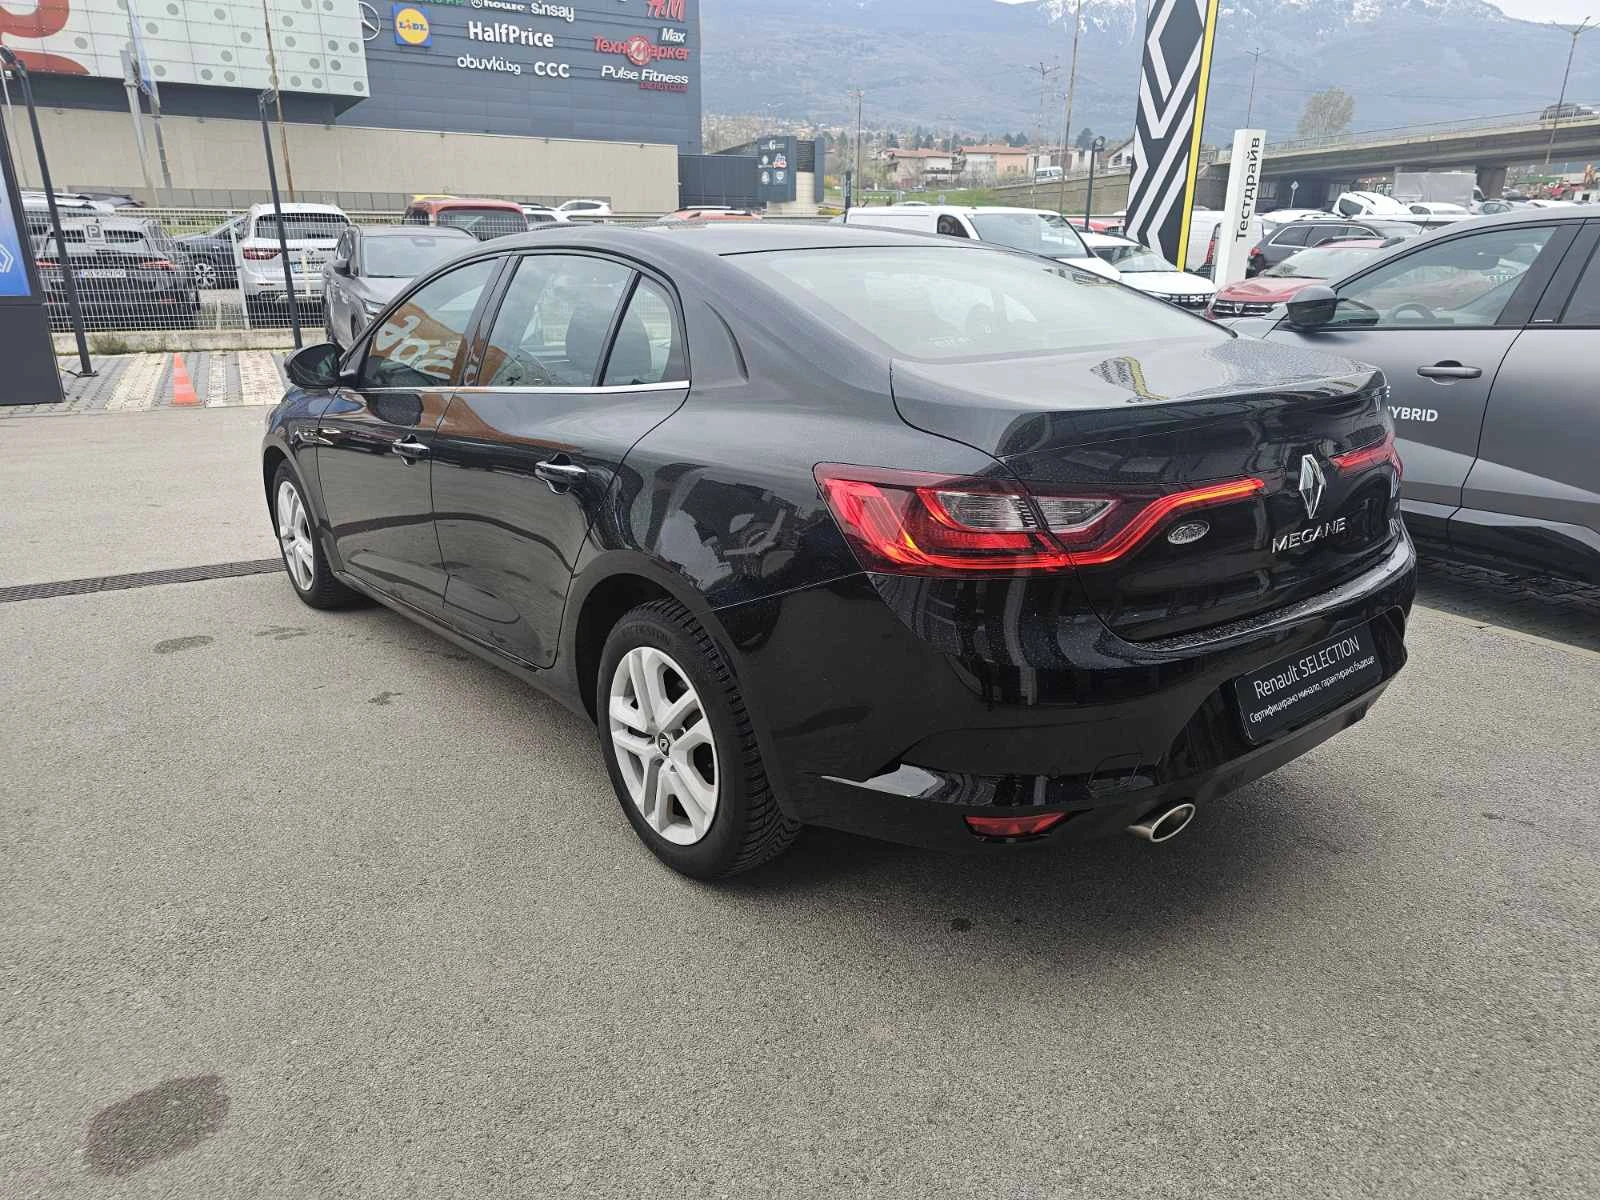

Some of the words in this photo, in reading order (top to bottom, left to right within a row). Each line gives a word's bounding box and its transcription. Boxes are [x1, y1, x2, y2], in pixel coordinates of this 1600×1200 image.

[531, 0, 575, 22] sinsay
[468, 20, 554, 48] HalfPrice
[661, 27, 686, 43] Max
[457, 53, 521, 76] obuvki.bg
[534, 61, 570, 79] CCC
[601, 65, 640, 80] Pulse
[641, 68, 689, 84] Fitness
[1235, 137, 1260, 243] Тестдрайв
[1388, 405, 1439, 422] YBRID
[1271, 517, 1346, 554] MEGANE
[1253, 665, 1300, 700] Renault
[1299, 635, 1360, 678] SELECTION
